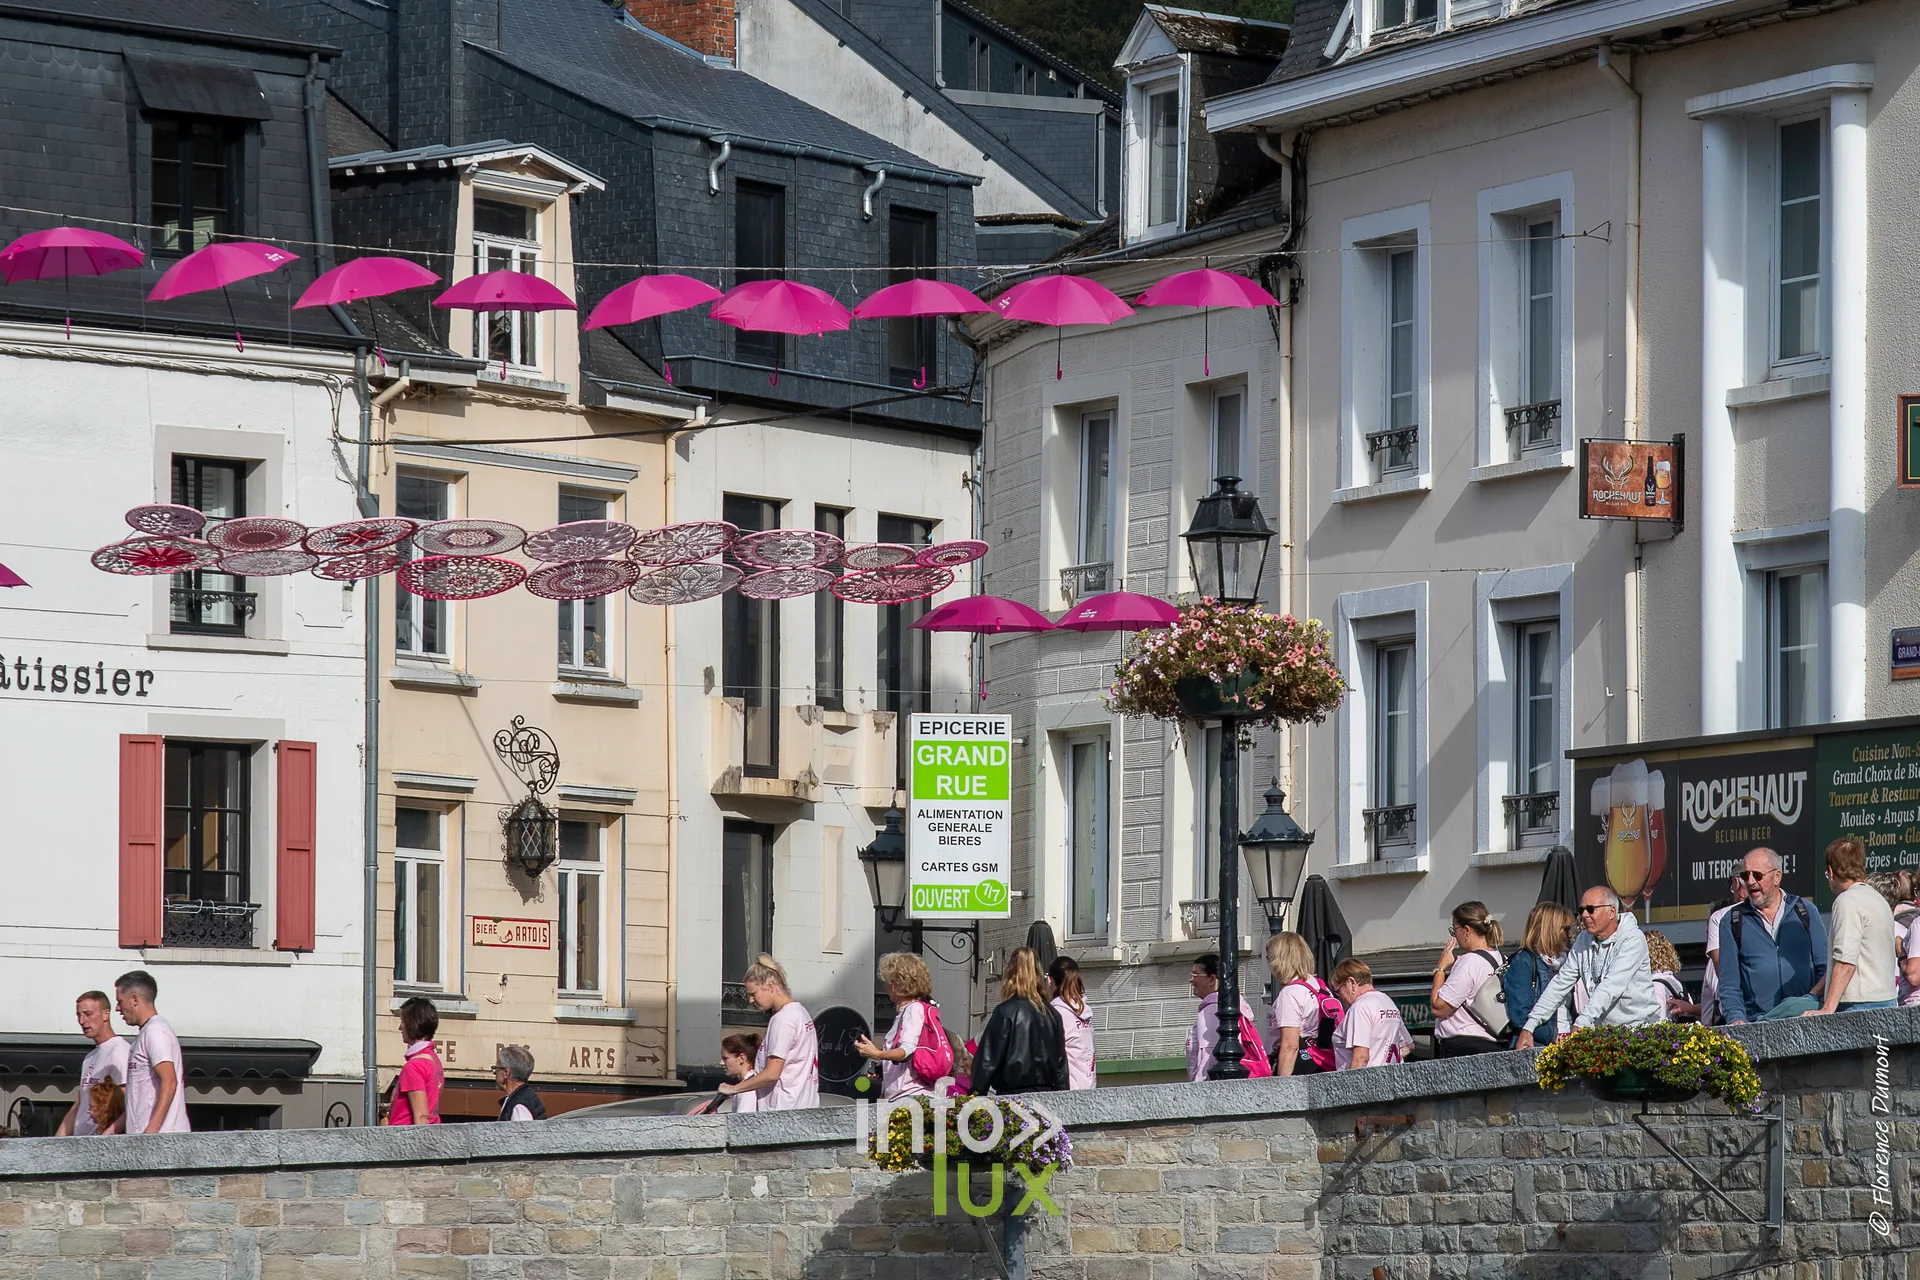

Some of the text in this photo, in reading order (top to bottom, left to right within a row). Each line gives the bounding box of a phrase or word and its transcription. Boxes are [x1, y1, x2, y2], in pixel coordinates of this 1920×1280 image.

[1592, 489, 1642, 504] ROCHEHAUT
[1897, 645, 1920, 659] GRAND-
[919, 721, 1005, 735] EPICERIE
[917, 745, 1006, 766] GRAND
[1852, 744, 1889, 762] Cuisine
[1833, 766, 1863, 786] Grand
[1864, 765, 1893, 783] Choix
[1894, 762, 1906, 780] de
[936, 775, 987, 796] RUE
[1682, 771, 1807, 832] ROCHEHAUT
[1828, 791, 1869, 807] Taverne
[1870, 788, 1879, 804] &
[917, 809, 1003, 819] ALIMENTATION
[1840, 809, 1875, 827] Moules
[1883, 808, 1915, 827] Angus
[928, 822, 993, 833] GENERALE
[1715, 826, 1772, 843] BELGIAN BEER
[938, 836, 982, 846] BIERES
[921, 861, 999, 873] CARTES GSM
[1865, 849, 1920, 871] rêpes Gau
[1692, 861, 1706, 880] UN
[915, 888, 970, 908] OUVERT
[982, 882, 1000, 902] 7/7
[476, 923, 547, 943] BIERE ARTOIS
[569, 1046, 616, 1069] ARTS
